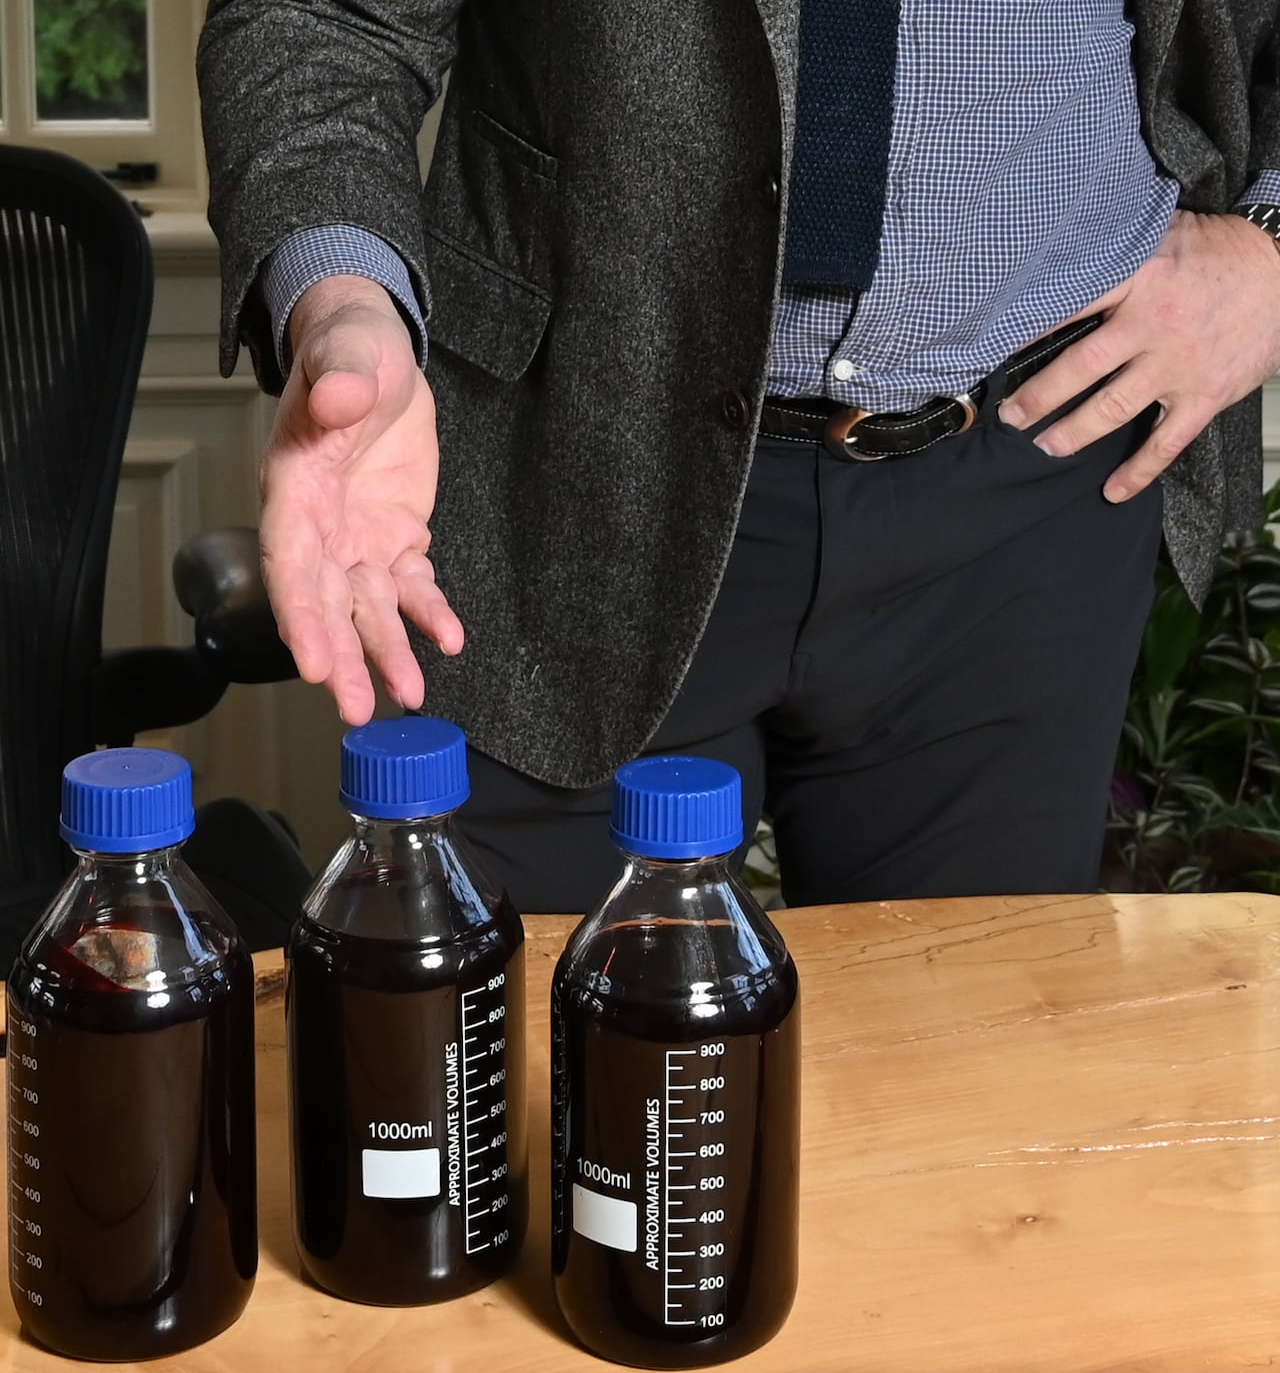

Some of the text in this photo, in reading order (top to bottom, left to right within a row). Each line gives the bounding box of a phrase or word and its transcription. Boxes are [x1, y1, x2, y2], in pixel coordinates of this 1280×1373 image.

[487, 973, 505, 991] 900
[488, 1005, 505, 1023] 800
[21, 1020, 37, 1037] 900
[489, 1038, 506, 1056] 700
[700, 1043, 725, 1057] 900
[22, 1054, 38, 1070] 800
[489, 1069, 506, 1087] 600
[700, 1077, 725, 1091] 800
[22, 1087, 39, 1104] 700
[490, 1100, 507, 1117] 500
[445, 1042, 461, 1206] APPROXIMATE VOLUMES
[699, 1110, 725, 1125] 700
[23, 1120, 40, 1137] 600
[369, 1121, 432, 1140] 1000ml
[490, 1132, 507, 1149] 400
[699, 1143, 725, 1158] 600
[24, 1153, 41, 1170] 500
[491, 1163, 508, 1181] 300
[577, 1158, 631, 1189] 1000ml
[646, 1098, 660, 1270] APPROXIMATE VOLUMES
[699, 1176, 725, 1190] 500
[24, 1187, 41, 1203] 400
[491, 1194, 509, 1213] 200
[699, 1209, 725, 1224] 400
[25, 1219, 42, 1237] 300
[493, 1229, 510, 1247] 100
[699, 1243, 725, 1258] 300
[26, 1252, 43, 1269] 200
[699, 1276, 724, 1291] 200
[27, 1290, 43, 1306] 100
[700, 1313, 724, 1328] 100
